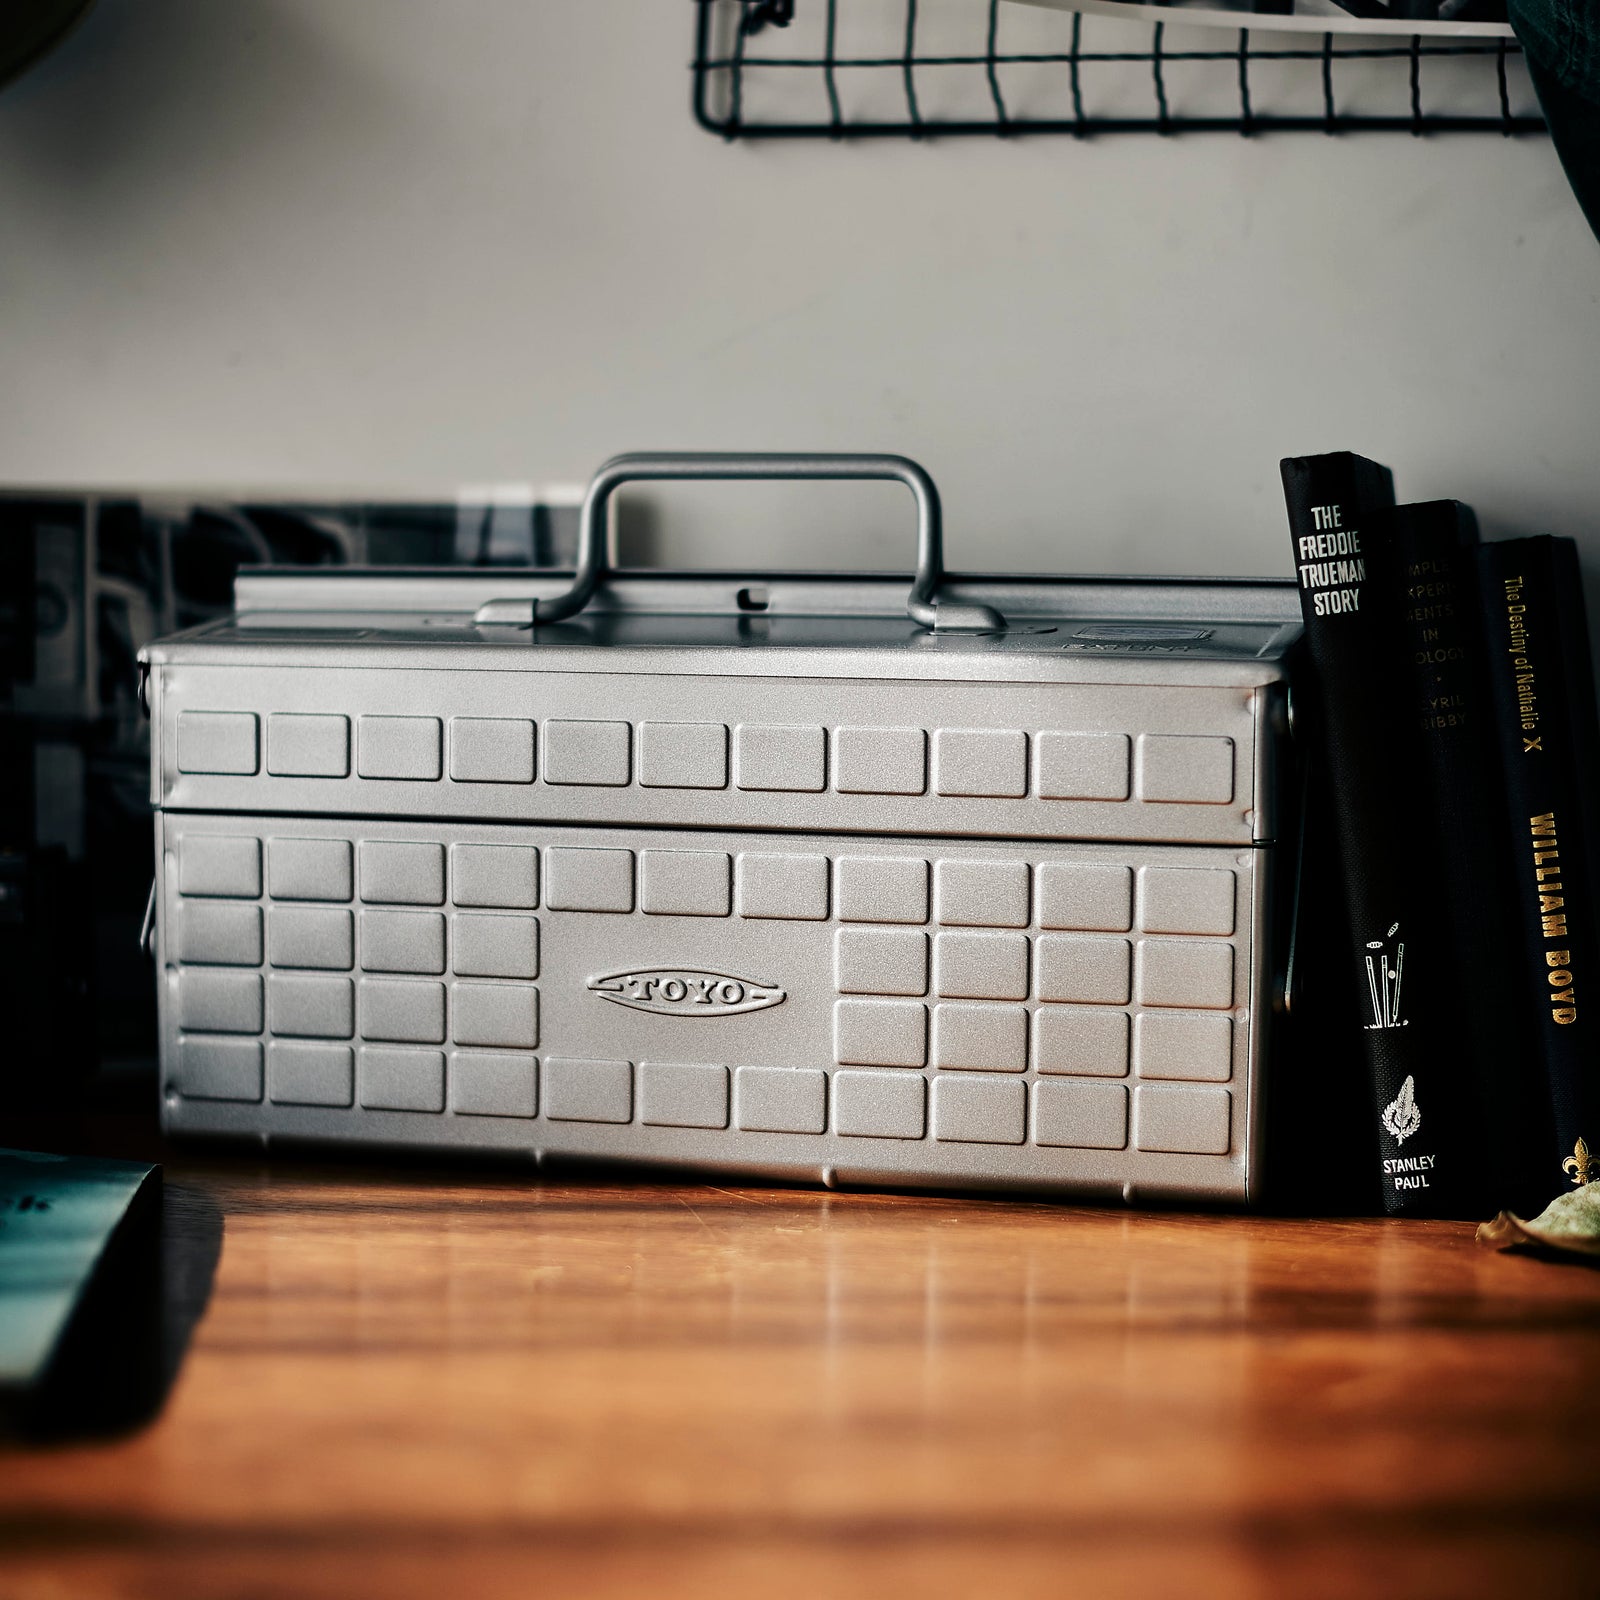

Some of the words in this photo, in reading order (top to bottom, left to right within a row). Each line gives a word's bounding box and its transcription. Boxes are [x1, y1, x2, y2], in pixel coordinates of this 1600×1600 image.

[1311, 504, 1342, 530] THE
[1299, 530, 1361, 560] FREDDIE
[1299, 558, 1367, 589] TRUEMAN
[1405, 559, 1448, 577] MPLE
[1504, 575, 1523, 601] The
[1313, 589, 1360, 616] STORY
[1422, 627, 1440, 643] IN
[1507, 604, 1530, 653] Destiny
[1414, 646, 1465, 664] OLOGY
[1514, 657, 1533, 670] of
[1421, 694, 1465, 712] YRIL
[1516, 673, 1539, 730] Nathalie
[1522, 736, 1543, 753] X
[1530, 812, 1568, 938] WILLIAM
[628, 975, 745, 1005] TOYO
[1545, 950, 1577, 1025] BOYD
[1383, 1154, 1436, 1174] STANLEY
[1394, 1175, 1430, 1190] PAUL
